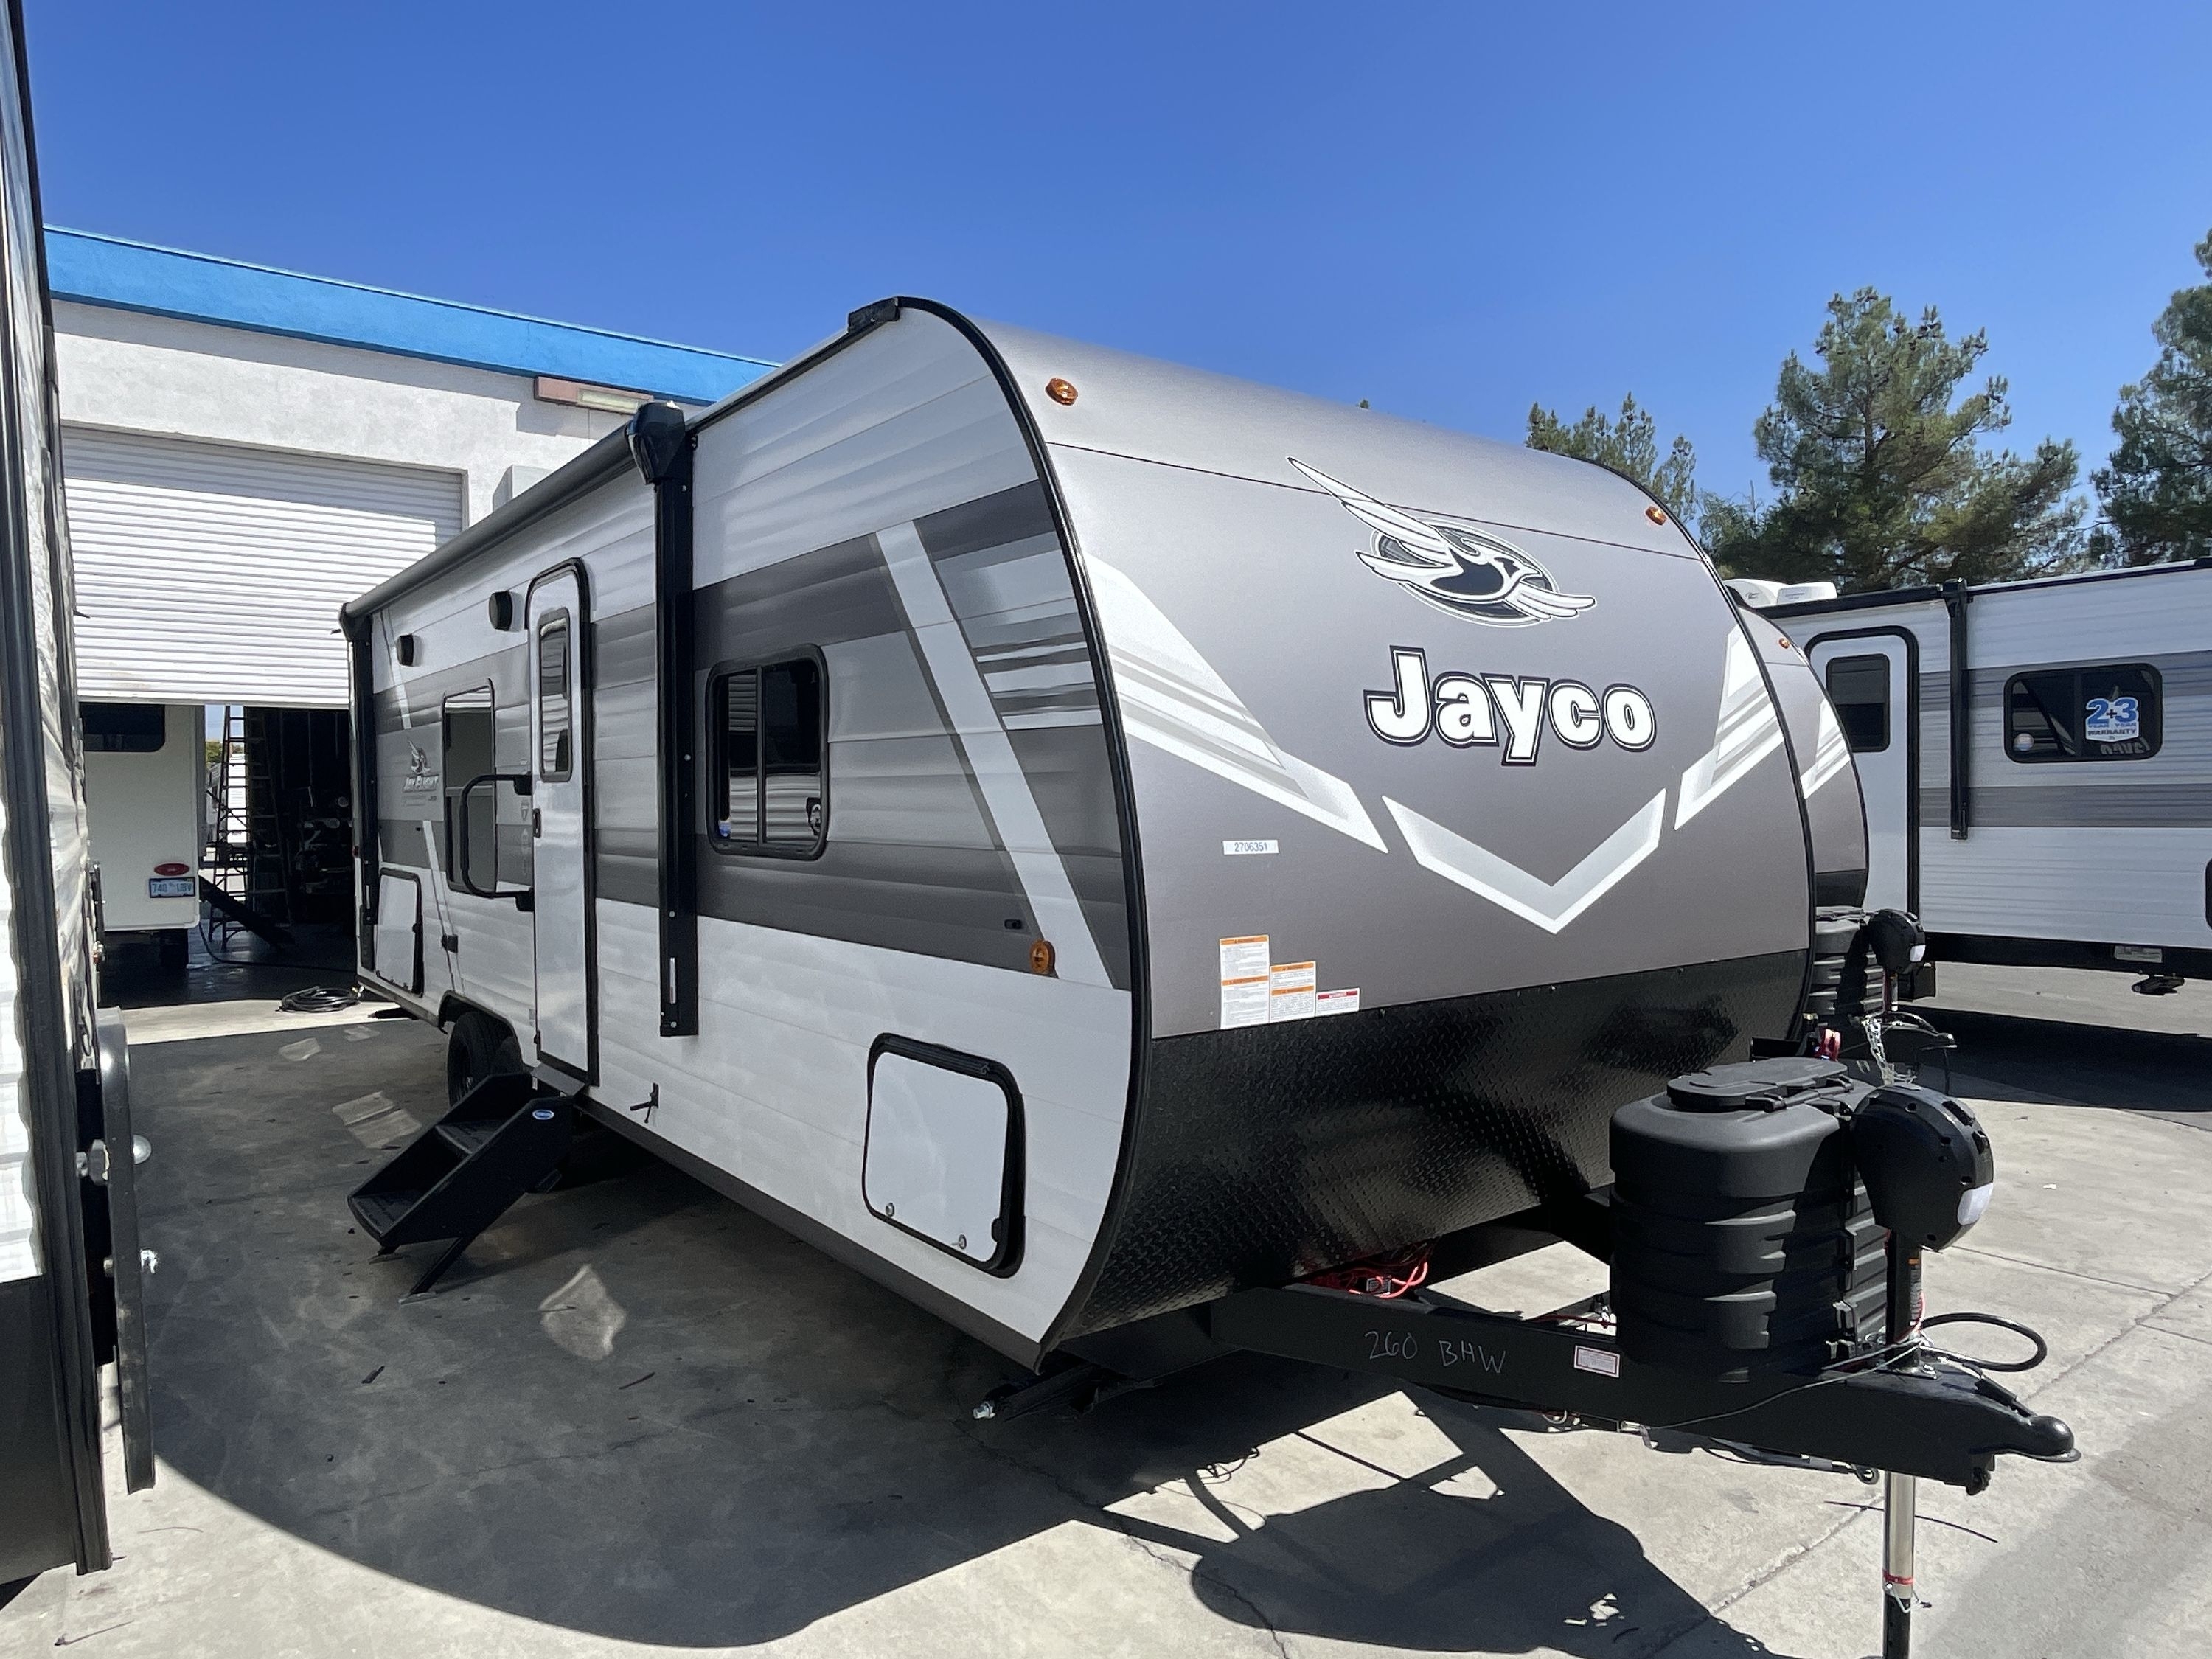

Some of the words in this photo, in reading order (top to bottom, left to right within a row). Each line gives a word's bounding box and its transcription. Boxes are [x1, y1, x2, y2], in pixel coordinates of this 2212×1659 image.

[1363, 645, 1657, 766] Jayco
[1234, 841, 1268, 852] 2706351
[1364, 1330, 1418, 1360] 260
[1439, 1339, 1506, 1374] BHW
